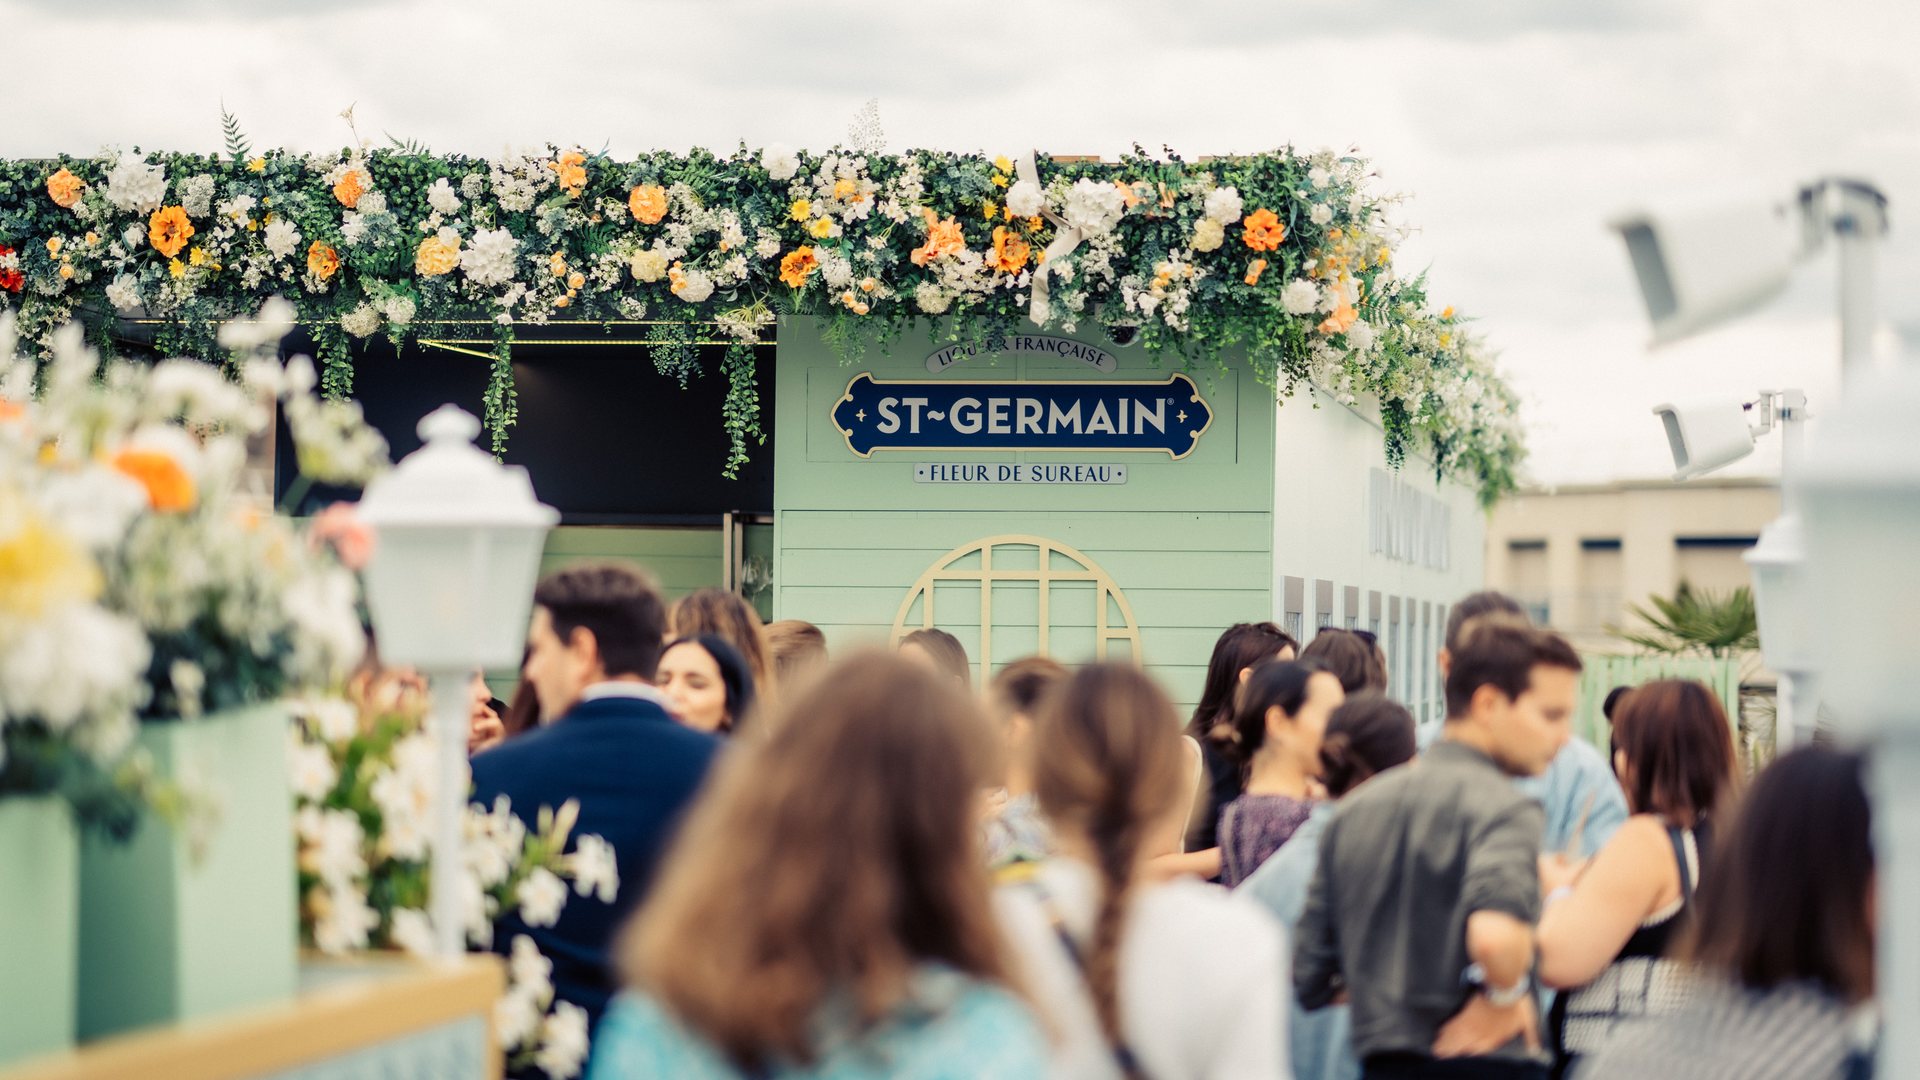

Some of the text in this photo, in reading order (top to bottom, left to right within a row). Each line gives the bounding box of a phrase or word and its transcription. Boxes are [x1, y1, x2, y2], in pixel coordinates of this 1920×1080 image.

[1015, 337, 1106, 366] FRANÇAISE
[930, 465, 1111, 482] FLEUR DE SUREAU
